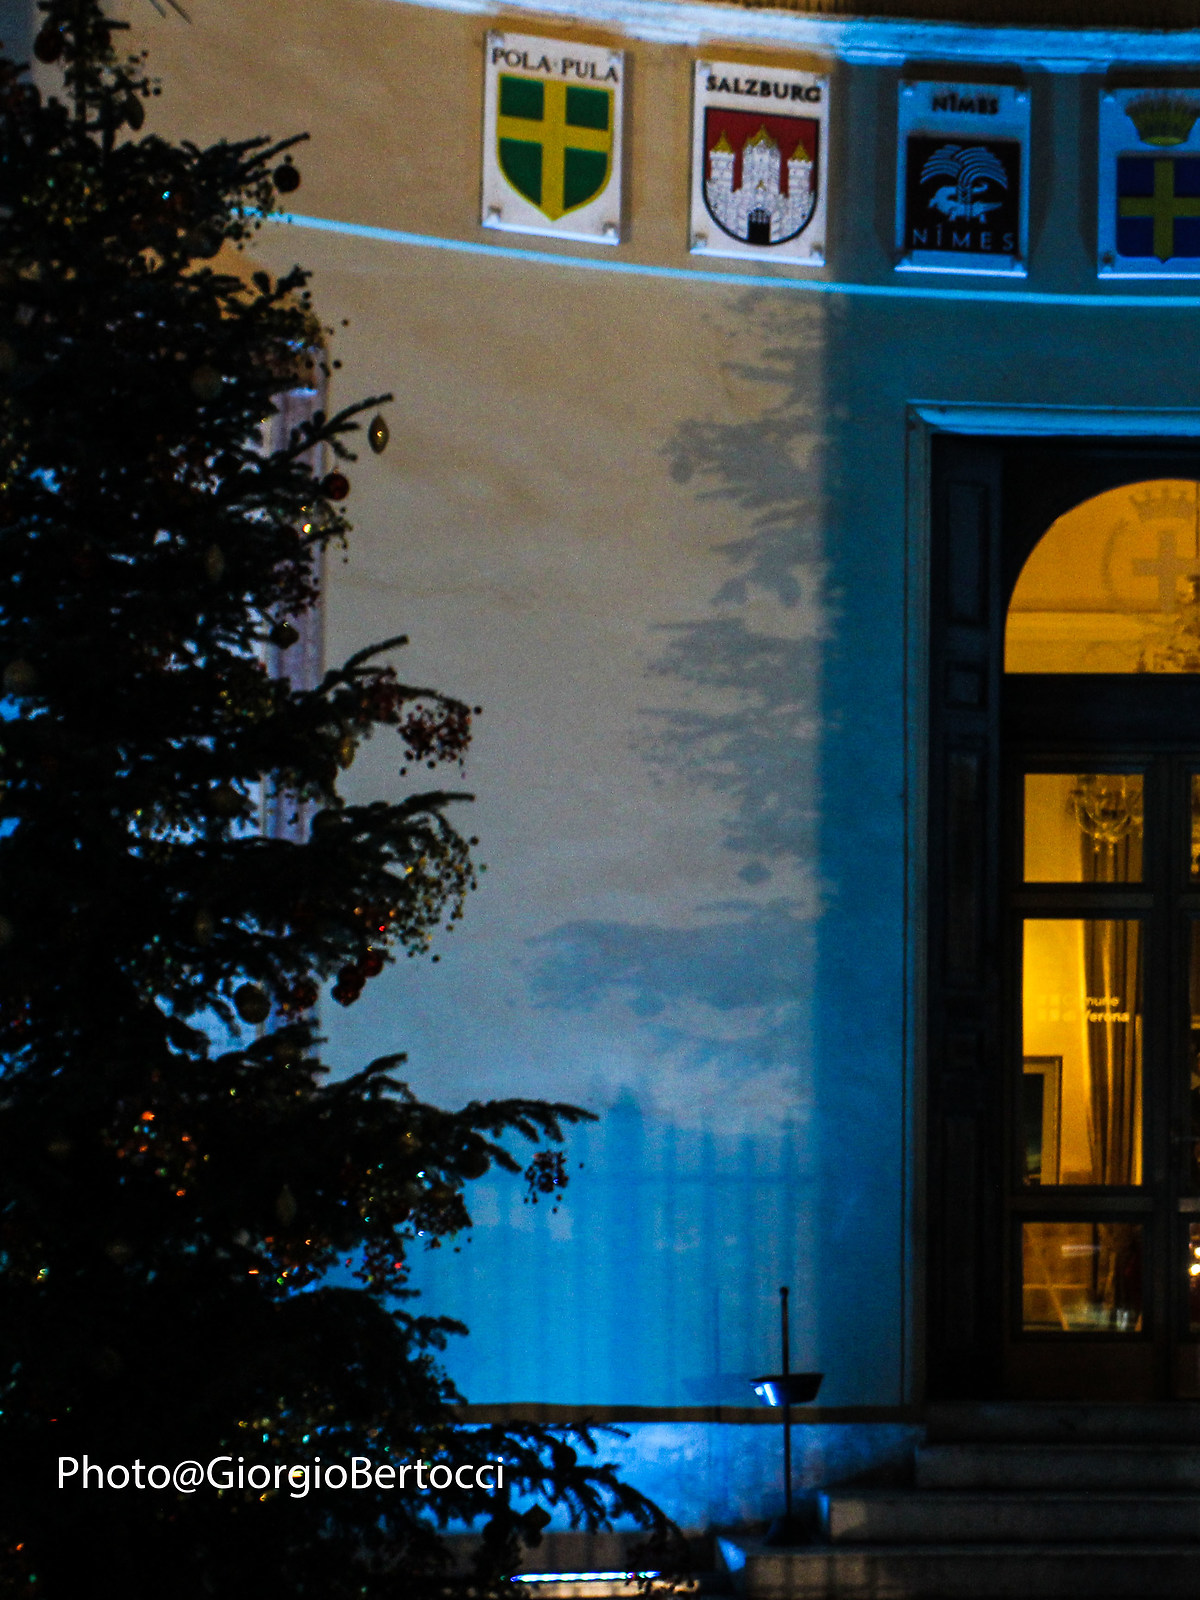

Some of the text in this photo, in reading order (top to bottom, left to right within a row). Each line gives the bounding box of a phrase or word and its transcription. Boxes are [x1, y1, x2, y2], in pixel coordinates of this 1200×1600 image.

[492, 47, 618, 82] POLA PULA
[706, 75, 822, 103] SALZBURG
